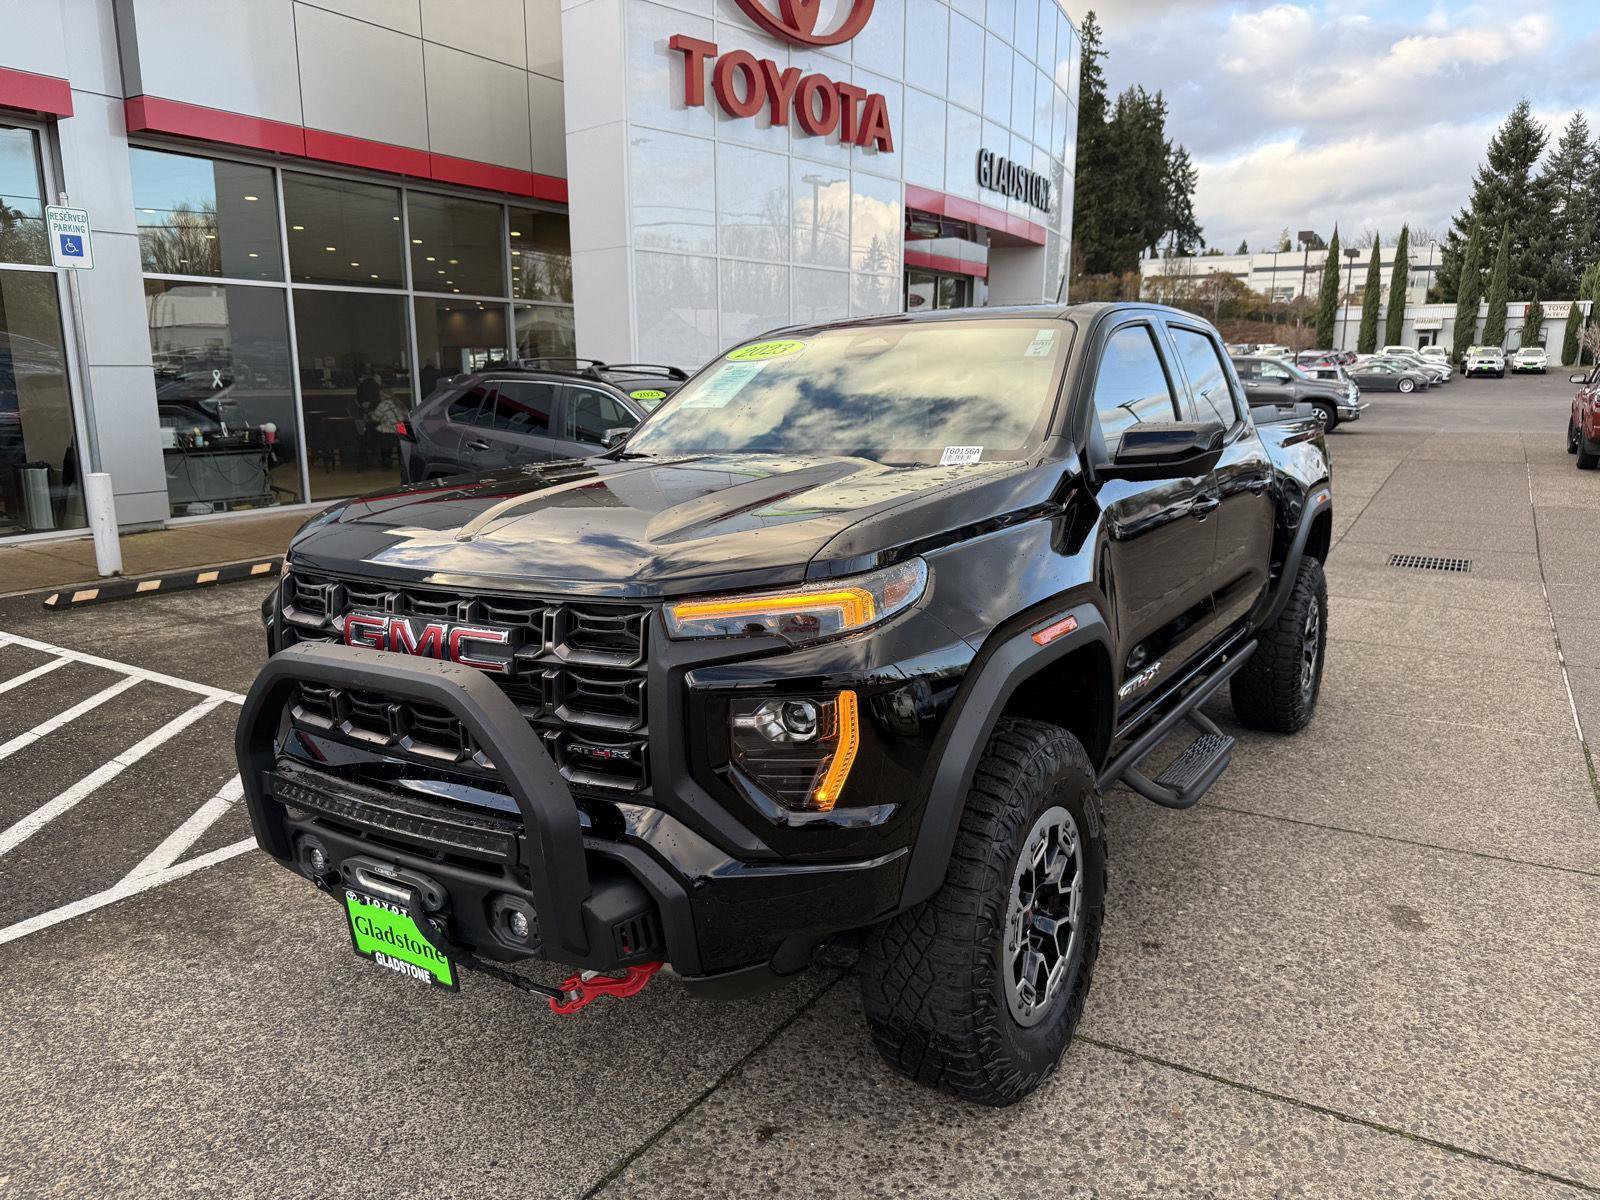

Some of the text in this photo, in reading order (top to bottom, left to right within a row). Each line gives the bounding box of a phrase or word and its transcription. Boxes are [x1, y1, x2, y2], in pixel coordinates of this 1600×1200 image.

[669, 33, 894, 153] TOYOTA
[49, 211, 87, 223] RESERVED
[53, 222, 86, 234] PARKING
[1547, 304, 1570, 312] TOYO
[734, 342, 796, 358] 2023
[343, 611, 510, 674] GMC
[363, 895, 413, 920] TOYOT
[354, 915, 447, 965] Gladstone
[375, 951, 432, 985] GLADSTONE
